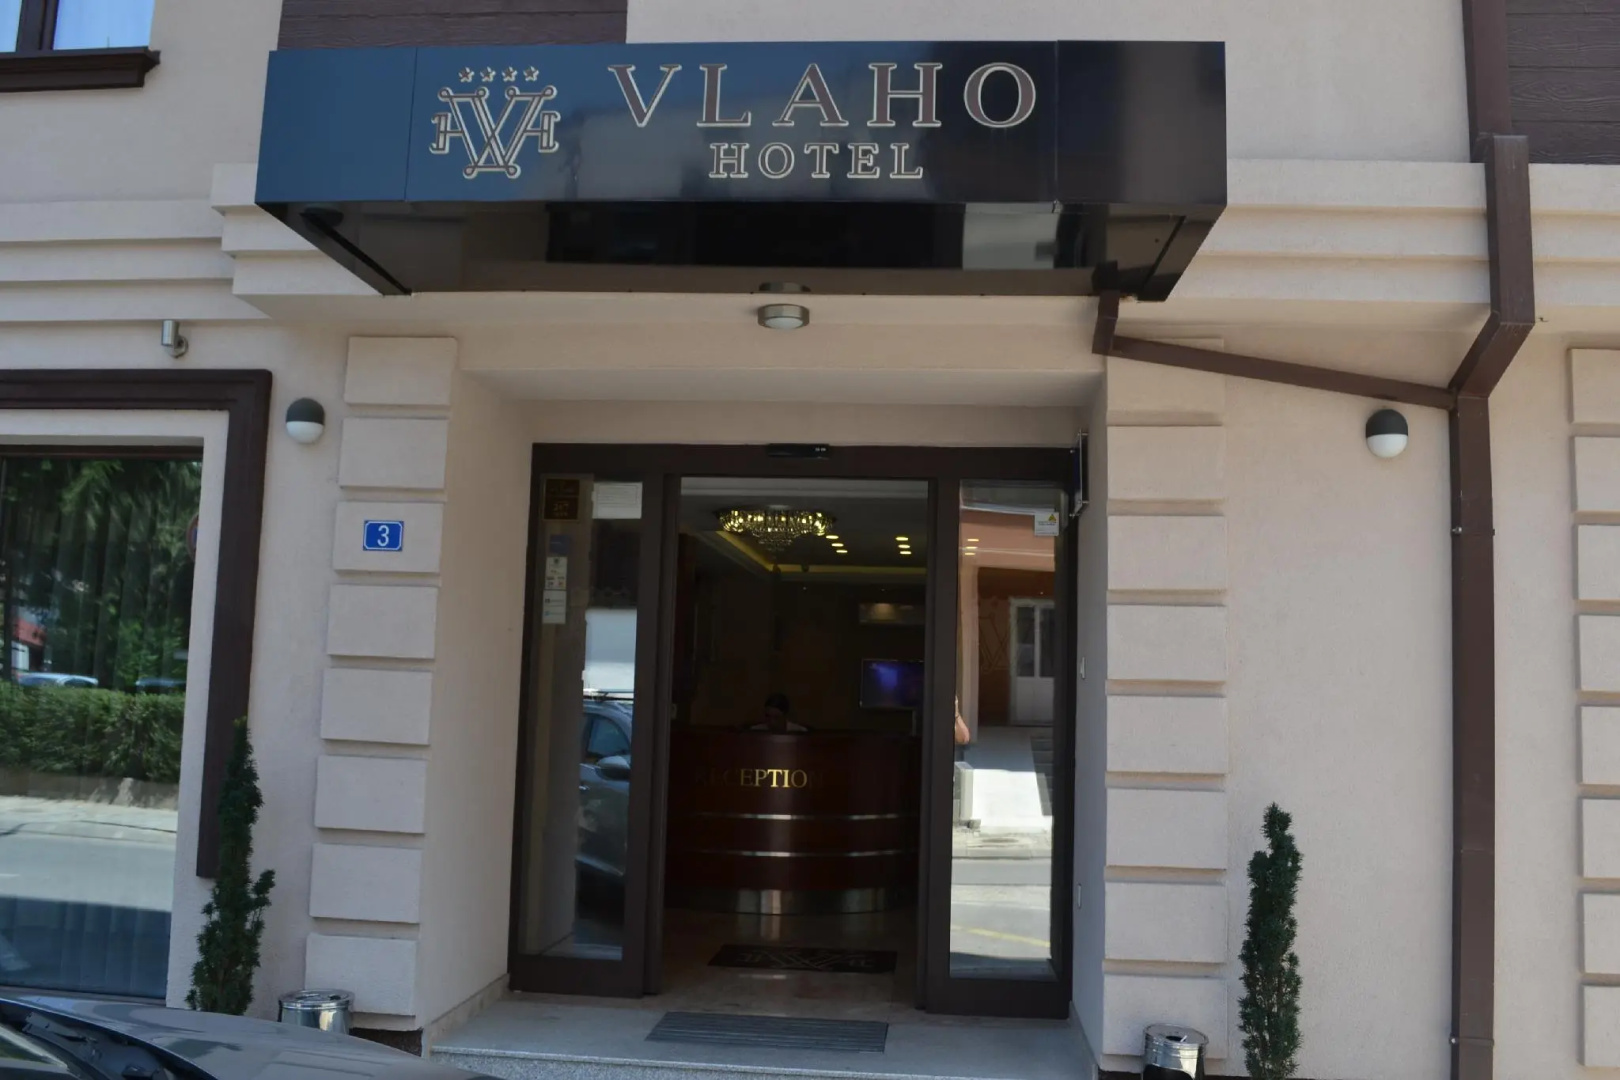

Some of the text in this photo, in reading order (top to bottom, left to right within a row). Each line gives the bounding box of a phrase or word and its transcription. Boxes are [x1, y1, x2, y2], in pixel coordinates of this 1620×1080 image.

[607, 62, 1037, 129] VLAHO
[708, 142, 924, 180] HOTEL
[377, 525, 390, 547] 3
